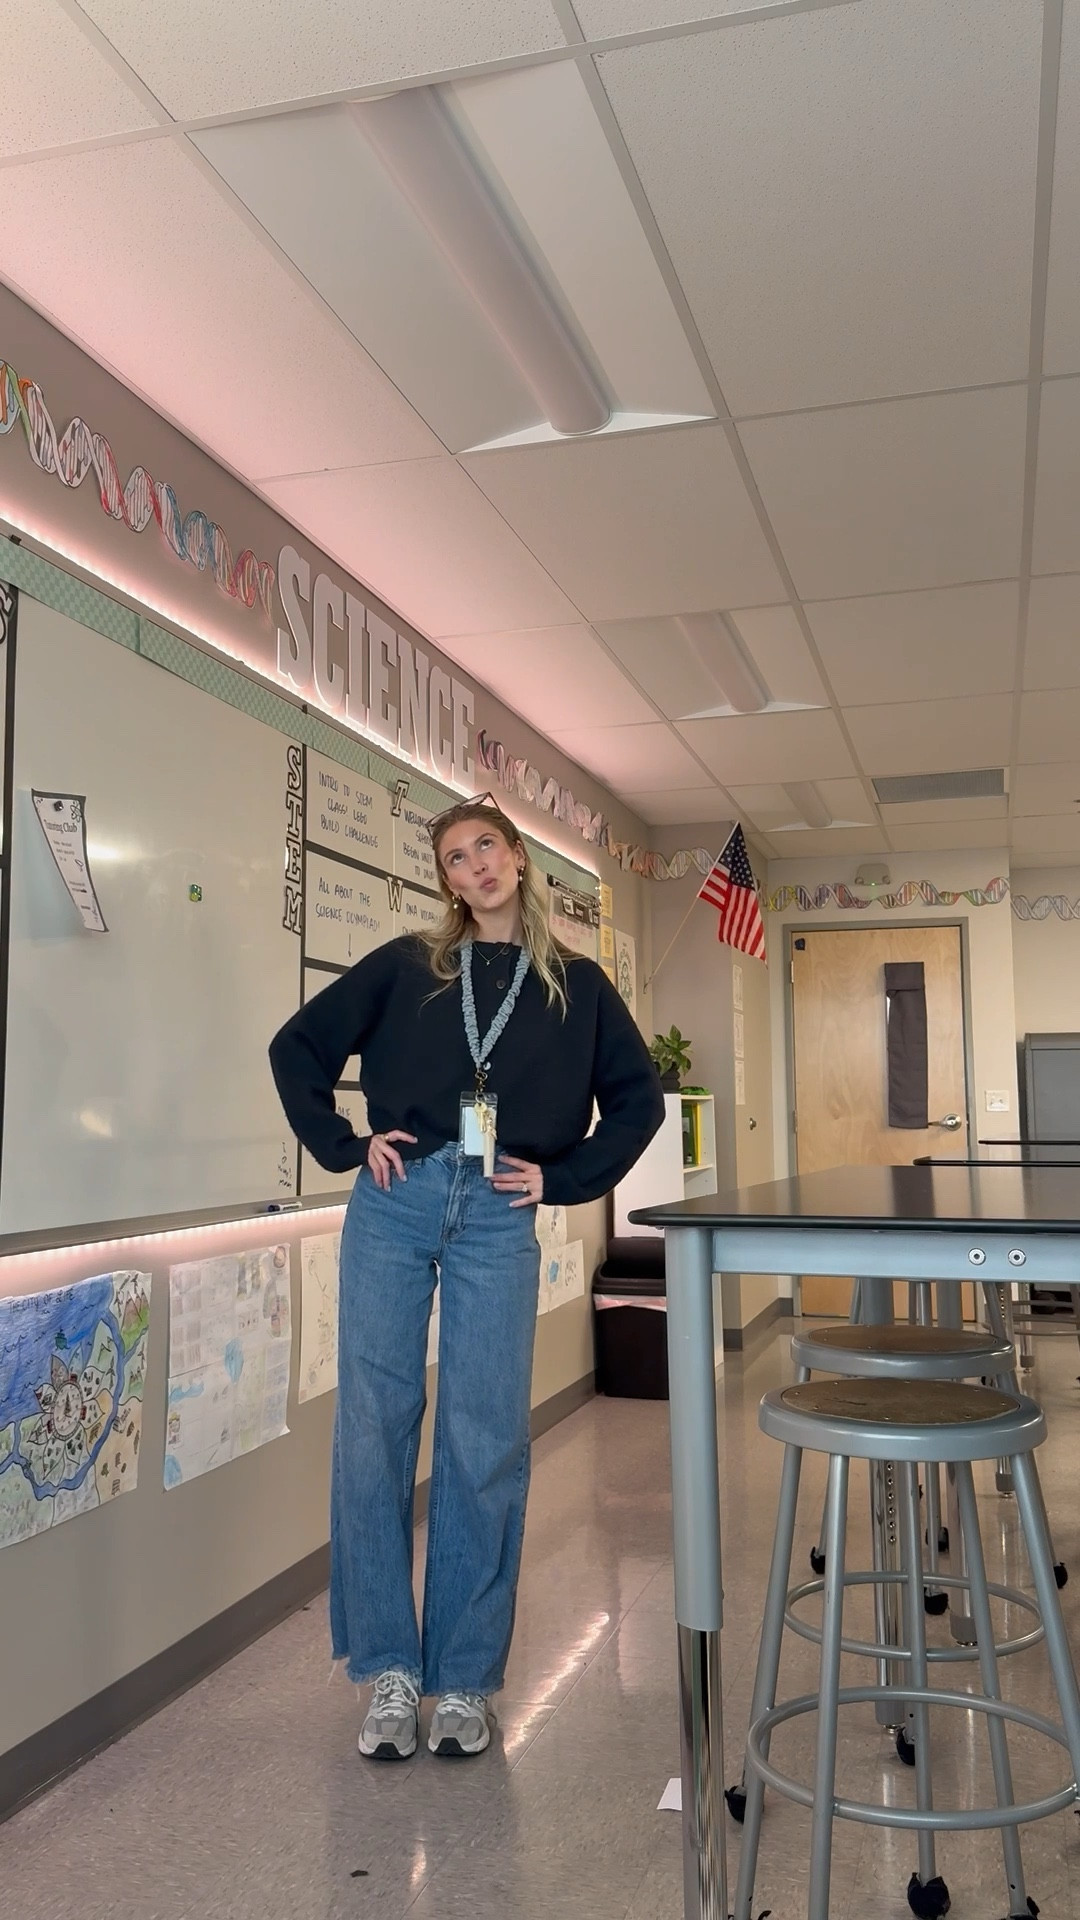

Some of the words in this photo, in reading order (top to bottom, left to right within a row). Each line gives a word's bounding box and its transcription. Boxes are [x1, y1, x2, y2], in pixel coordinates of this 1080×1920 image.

[277, 545, 475, 798] SCIENCE
[318, 771, 339, 793] INTRO
[343, 783, 351, 797] TO
[355, 790, 373, 809] STEM
[391, 779, 410, 817] T
[63, 822, 78, 833] Club
[283, 745, 303, 935] STEM
[320, 813, 340, 834] BUILD
[344, 824, 379, 849] CHALLENGE
[318, 877, 330, 895] ALL
[334, 884, 353, 901] ABOUT
[359, 892, 371, 907] THE
[387, 876, 404, 912] W
[315, 902, 343, 923] SCIENCE
